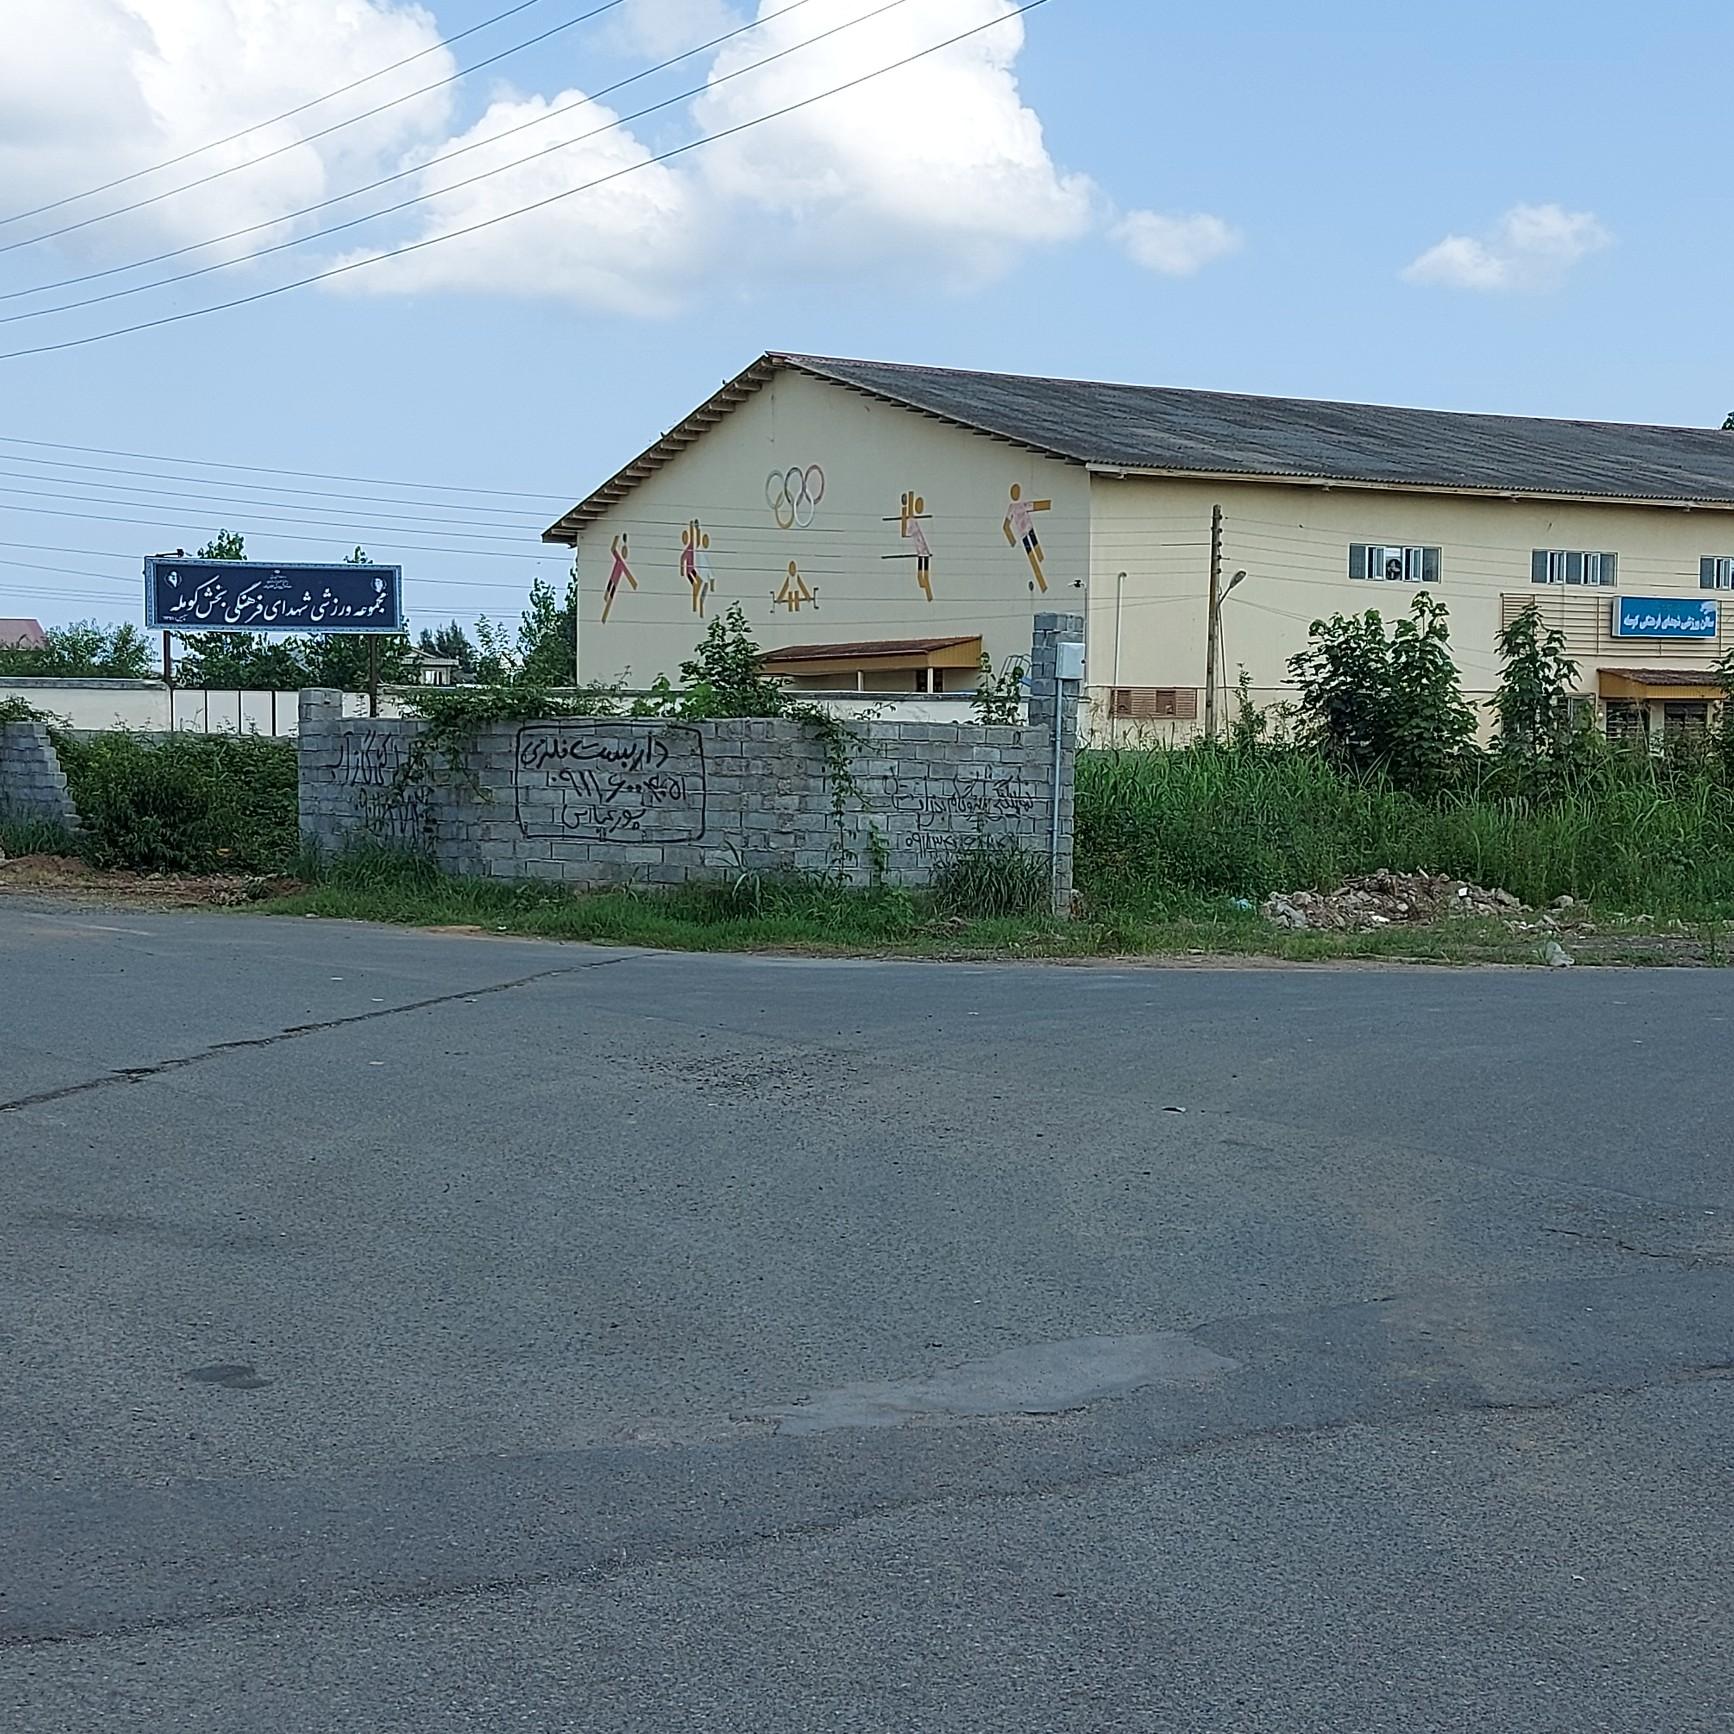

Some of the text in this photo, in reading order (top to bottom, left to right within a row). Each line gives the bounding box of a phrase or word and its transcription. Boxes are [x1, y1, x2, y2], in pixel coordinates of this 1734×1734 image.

[170, 575, 220, 612] کومله
[195, 584, 228, 619] بخش
[224, 581, 264, 623] فرهنگی
[263, 590, 312, 621] شهدای
[310, 587, 351, 621] ورزشی
[353, 592, 387, 617] مجموعه
[521, 732, 669, 771] داربست فلزی
